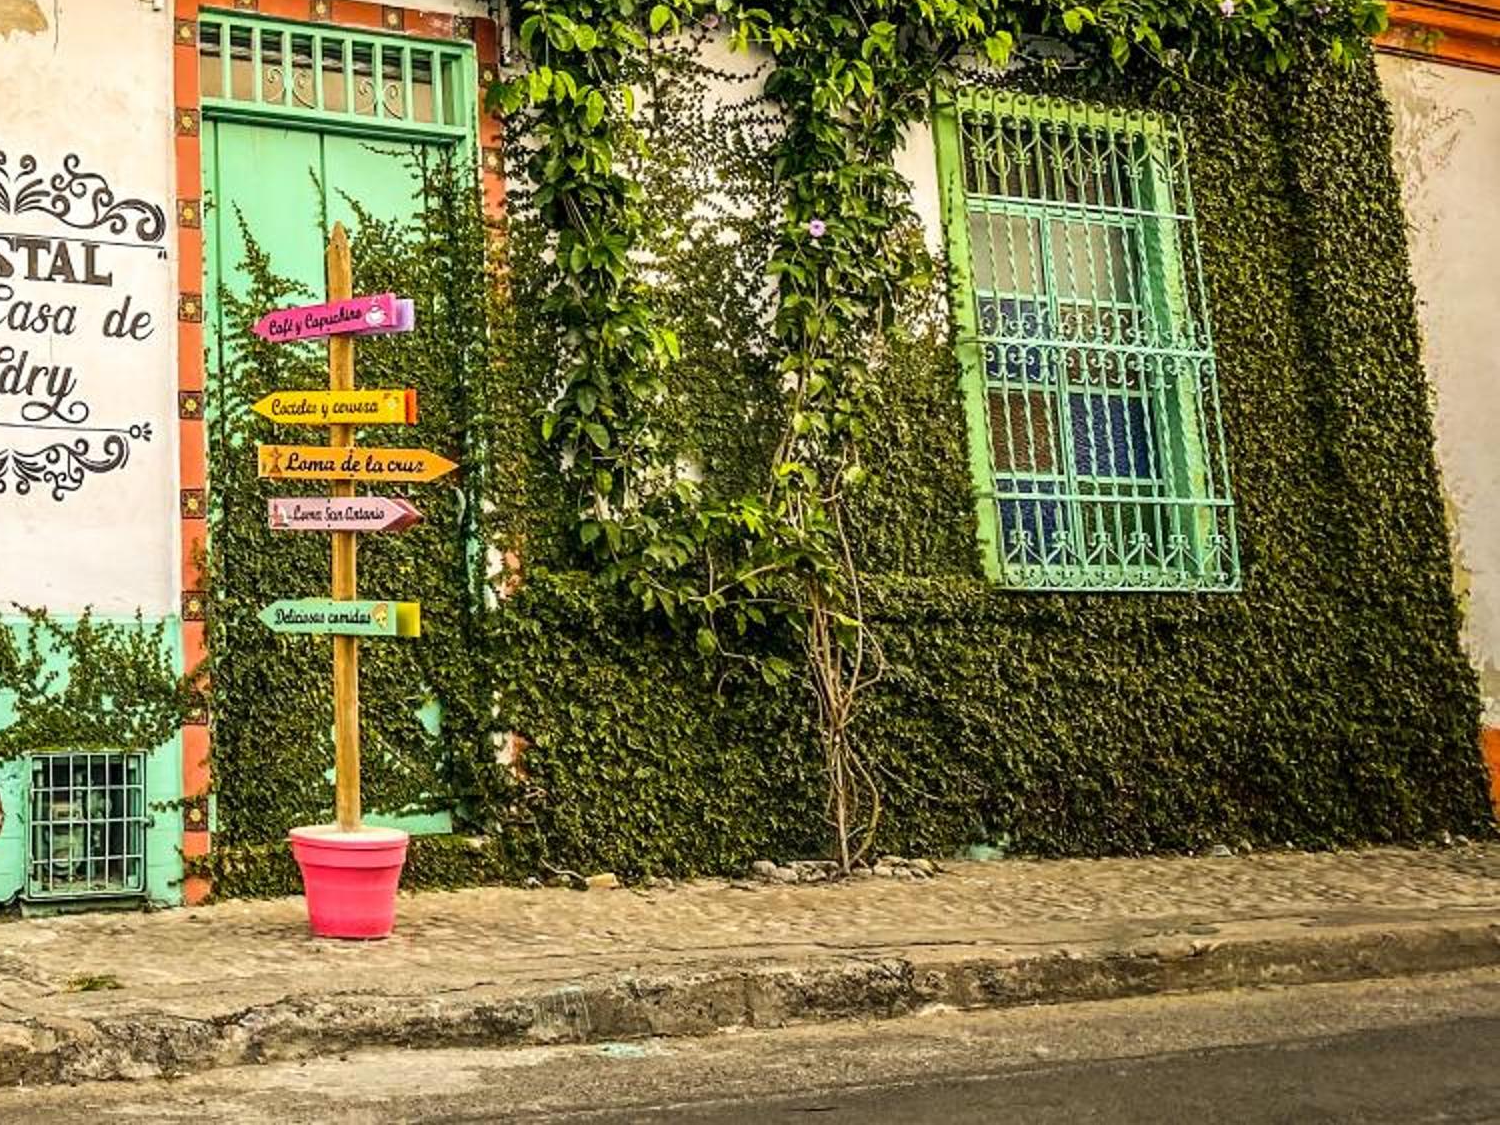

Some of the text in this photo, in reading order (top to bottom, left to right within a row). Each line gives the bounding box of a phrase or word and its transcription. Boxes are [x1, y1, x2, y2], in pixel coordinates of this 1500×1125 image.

[103, 295, 155, 341] de
[295, 321, 303, 335] y
[321, 402, 329, 418] y
[285, 452, 426, 473] Loma de la cruz
[293, 504, 385, 521] Loma San Antonio
[327, 607, 372, 624] comidas
